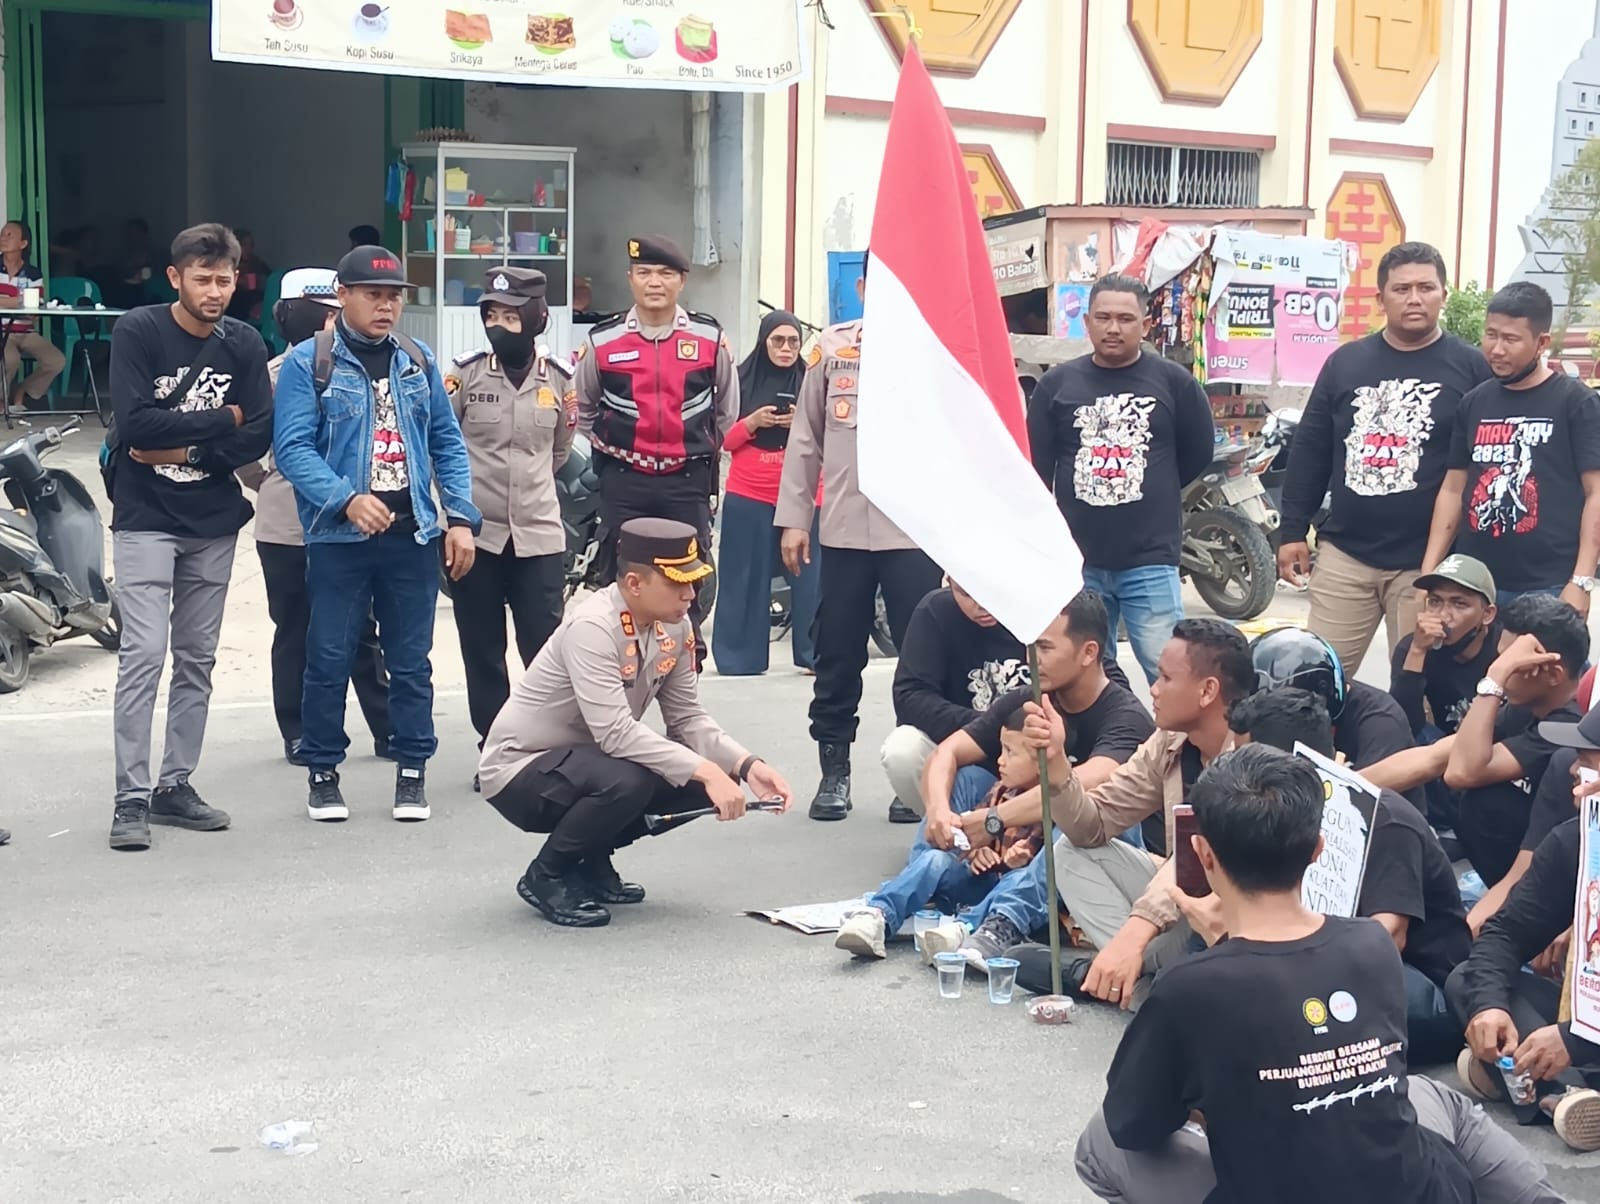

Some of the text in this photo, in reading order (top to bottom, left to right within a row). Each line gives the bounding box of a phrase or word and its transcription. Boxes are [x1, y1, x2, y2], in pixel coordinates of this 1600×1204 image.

[264, 37, 309, 53] Teh Susu
[346, 45, 395, 60] Kopi Susu
[450, 51, 484, 68] Srikaya
[735, 60, 793, 80] Since 1950
[469, 393, 499, 403] DEBI
[1475, 424, 1513, 444] MAY
[1361, 445, 1401, 459] DAY
[1091, 456, 1131, 470] DAY
[1298, 1073, 1332, 1089] BURUH
[1332, 1067, 1356, 1081] DAN
